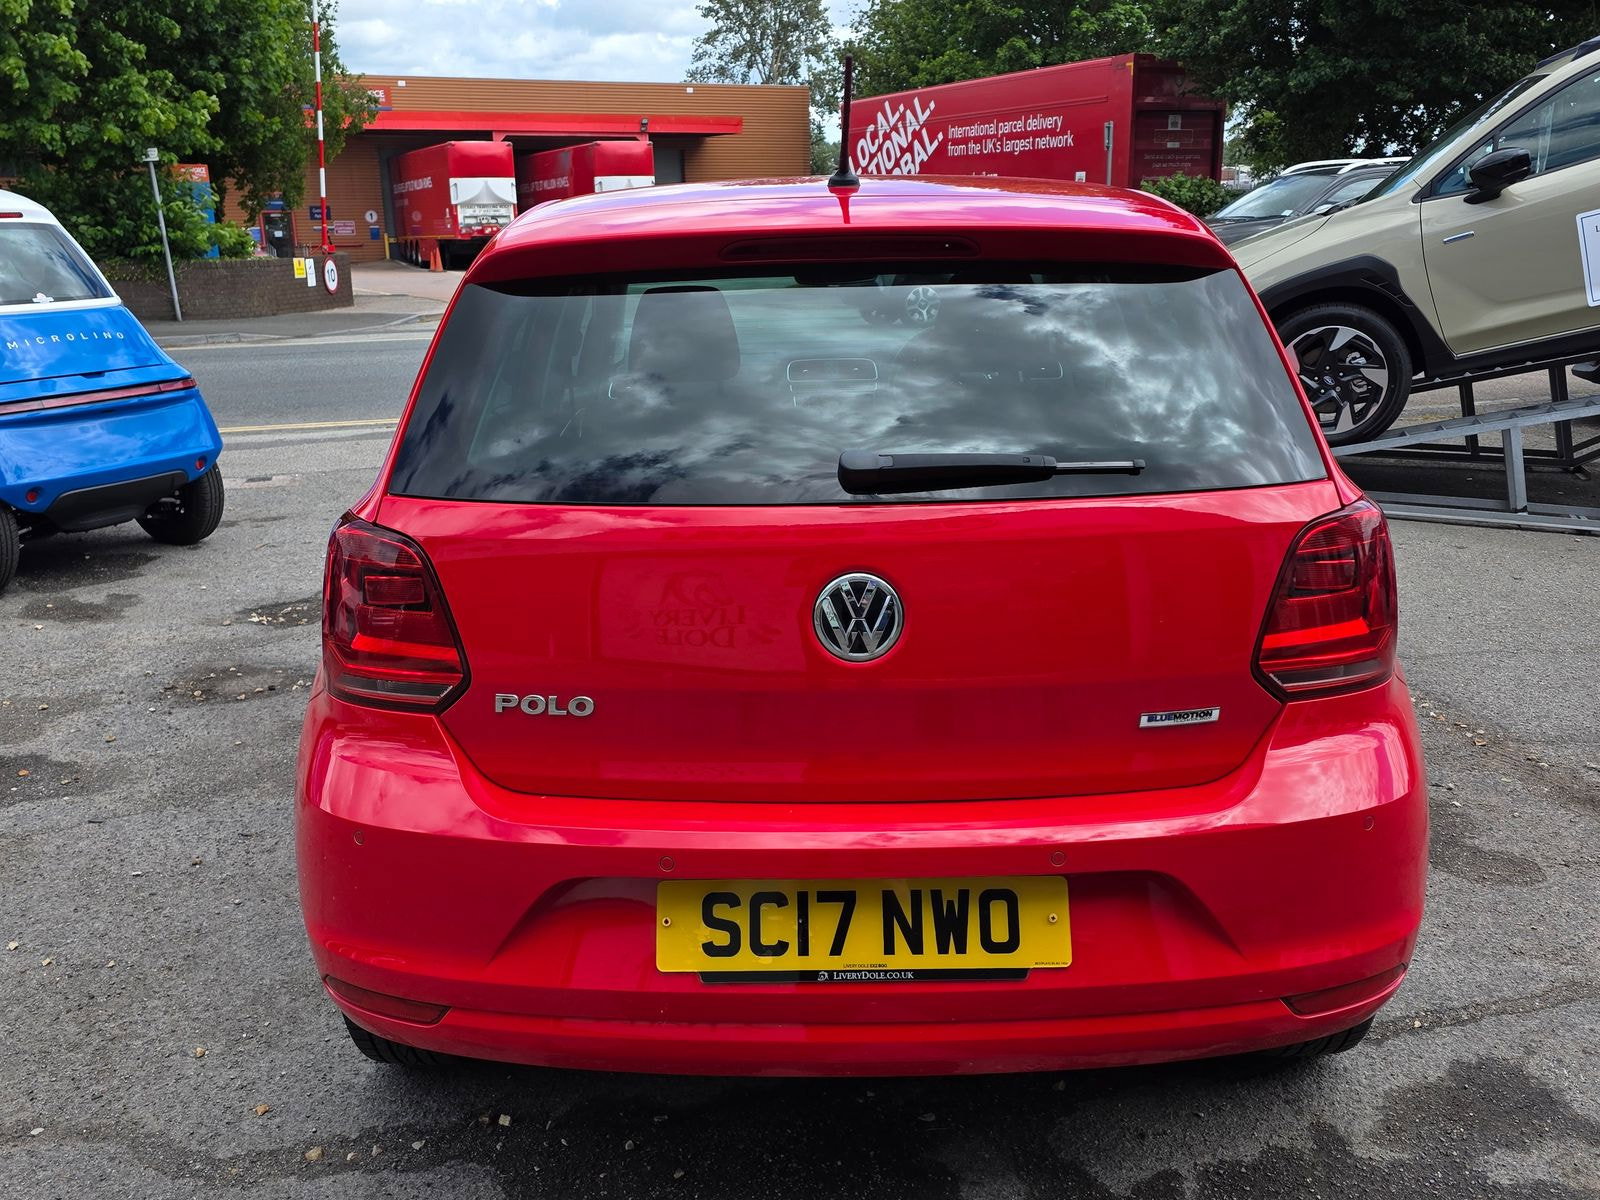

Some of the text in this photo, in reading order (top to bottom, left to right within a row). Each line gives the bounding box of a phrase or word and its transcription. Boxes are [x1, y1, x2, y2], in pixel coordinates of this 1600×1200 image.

[868, 96, 936, 175] TIONAL.
[948, 114, 1063, 139] International parcel delivery
[948, 130, 1074, 157] from the UK's largest network
[327, 268, 336, 282] 10
[6, 331, 124, 350] MICROLINO
[495, 693, 595, 717] POLO
[1146, 710, 1213, 722] BLUEMOTION
[701, 888, 1021, 958] SC17 NWO
